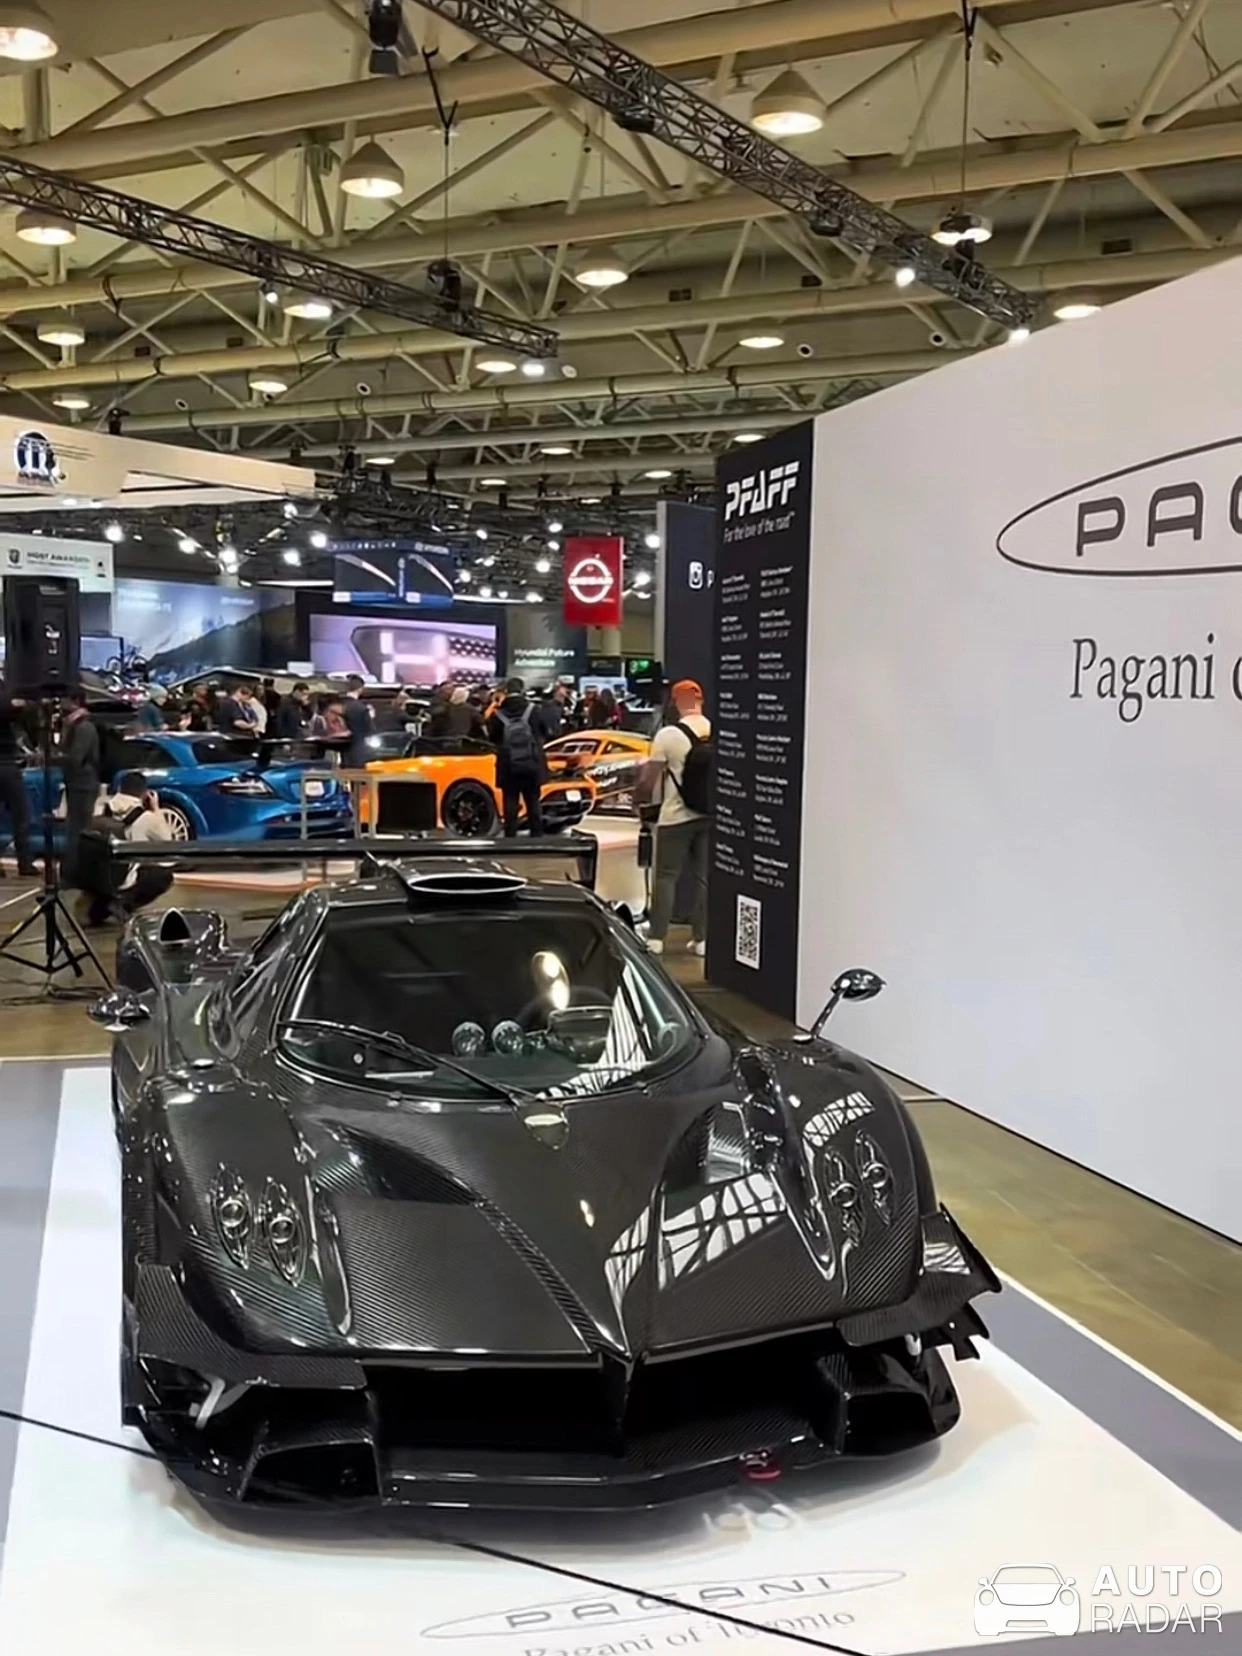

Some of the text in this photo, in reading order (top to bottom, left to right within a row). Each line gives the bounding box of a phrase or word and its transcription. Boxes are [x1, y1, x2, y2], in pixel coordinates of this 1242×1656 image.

[725, 461, 799, 521] PFAFF
[1076, 474, 1242, 557] PA
[1070, 633, 1215, 722] Pagani
[505, 1576, 830, 1628] PAGANI
[666, 1627, 703, 1647] of
